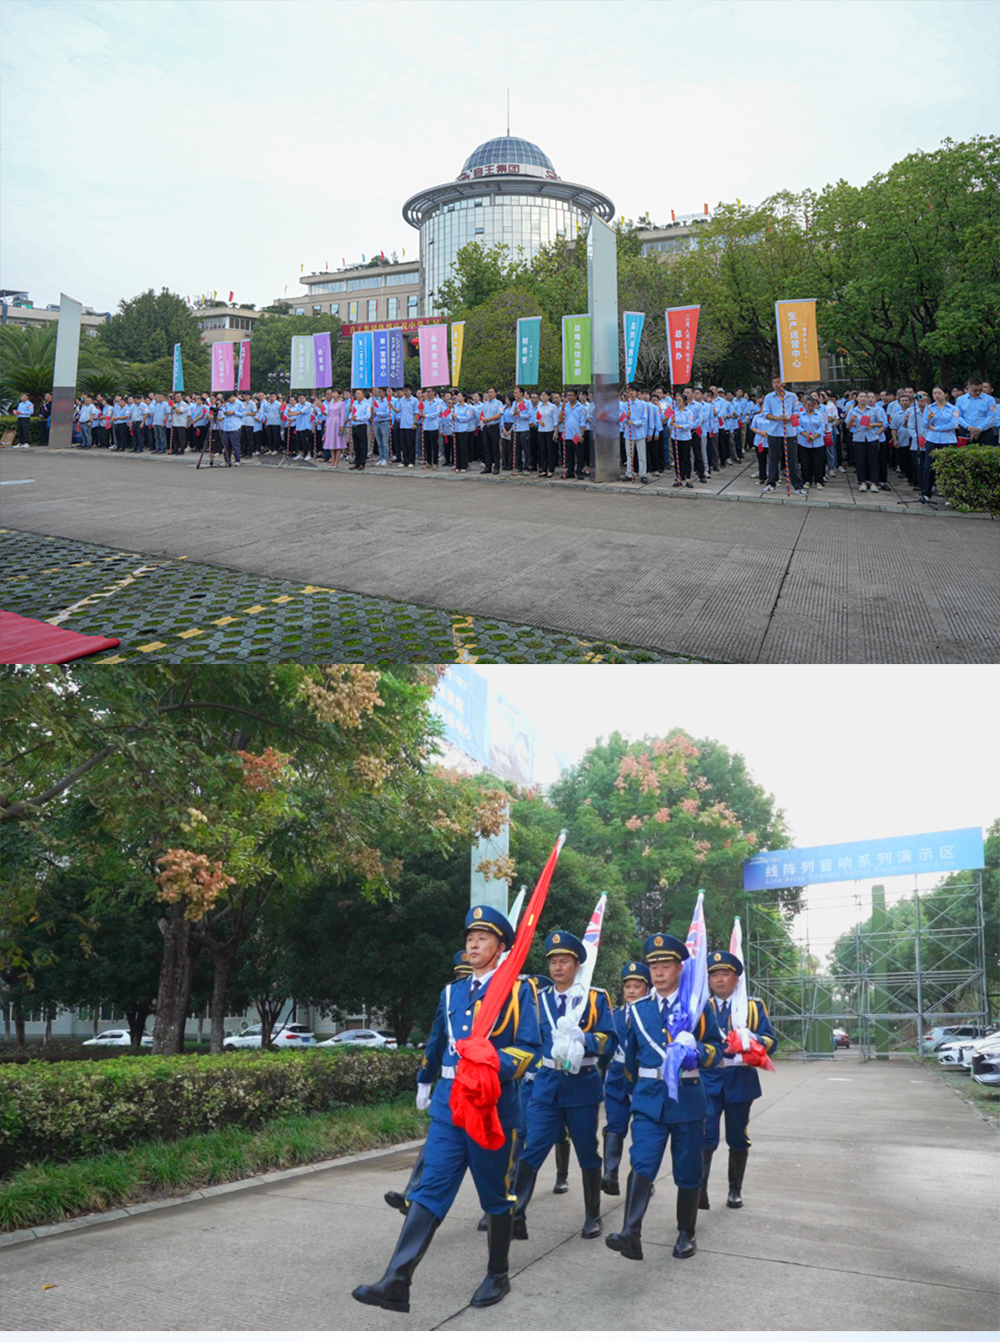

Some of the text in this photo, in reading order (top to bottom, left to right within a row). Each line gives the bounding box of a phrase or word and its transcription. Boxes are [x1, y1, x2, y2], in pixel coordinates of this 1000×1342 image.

[473, 164, 520, 177] 音王集团
[787, 312, 801, 368] 生产运营中心
[765, 845, 955, 878] 线阵列音响系列演示区
[766, 877, 782, 885] Line
[785, 875, 806, 884] Array
[873, 862, 930, 873] Presentation
[934, 859, 955, 867] Area
